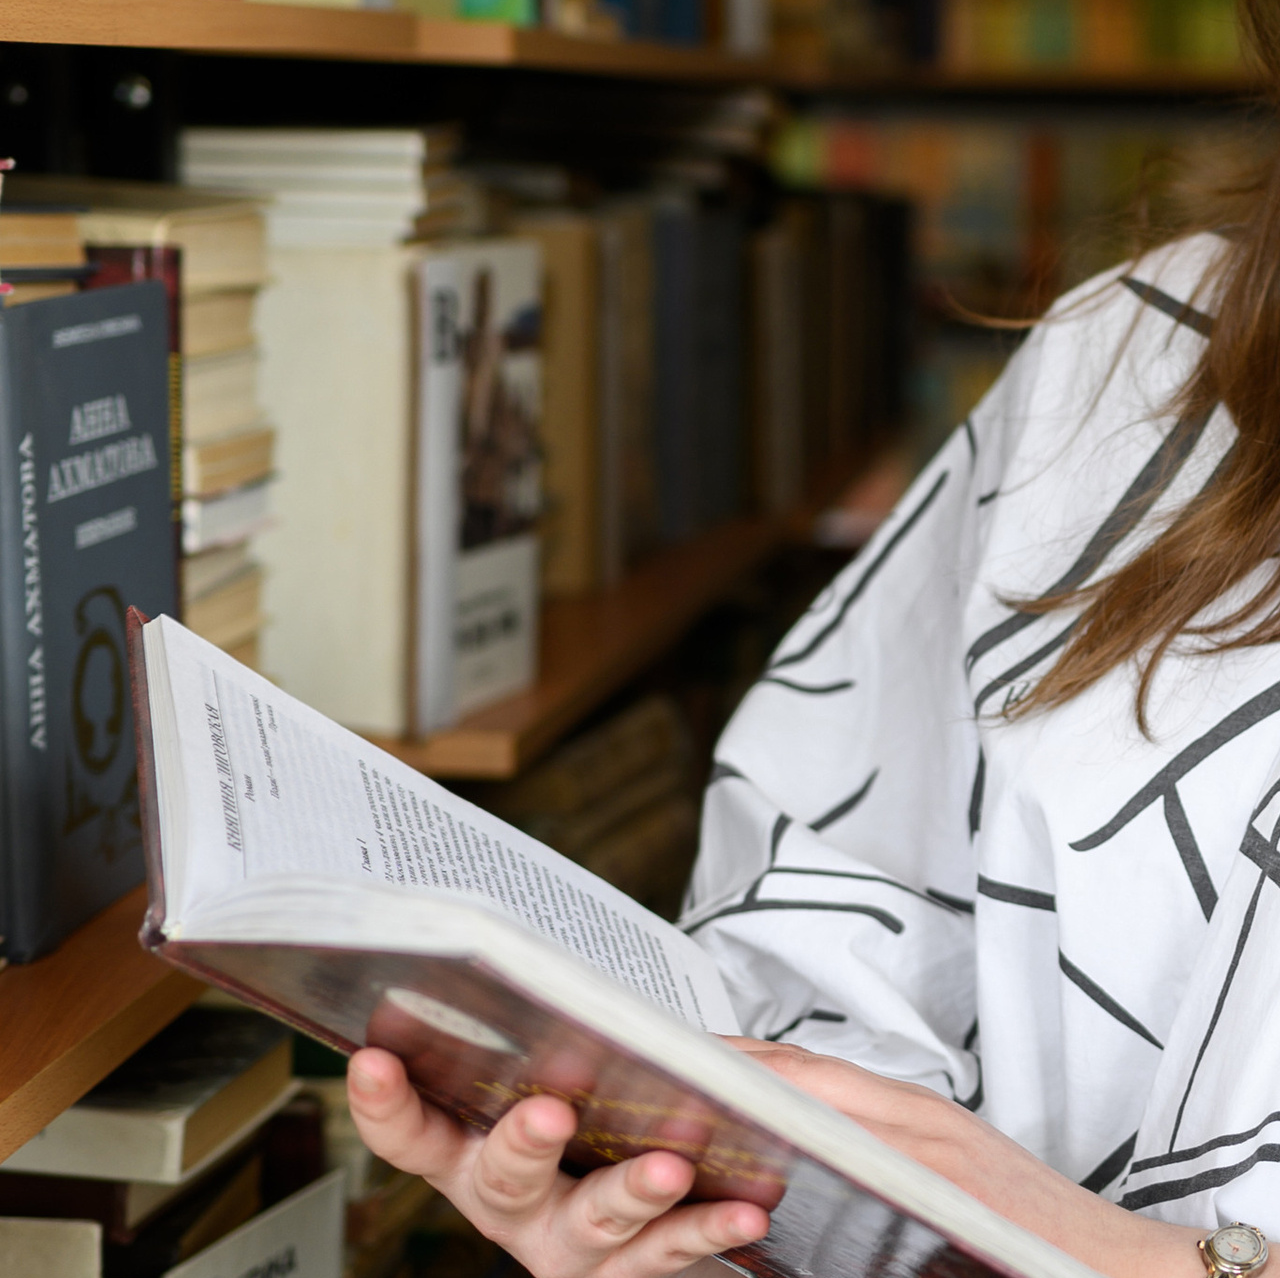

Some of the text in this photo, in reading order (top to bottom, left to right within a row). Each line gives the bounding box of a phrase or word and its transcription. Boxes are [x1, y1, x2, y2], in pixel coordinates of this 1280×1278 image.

[18, 431, 48, 751] АННА АХМАТОВА
[205, 704, 242, 853] КНЯГИНЯ ЛИГОВСКАЯ
[244, 773, 256, 802] Роман
[362, 846, 372, 872] Глава
